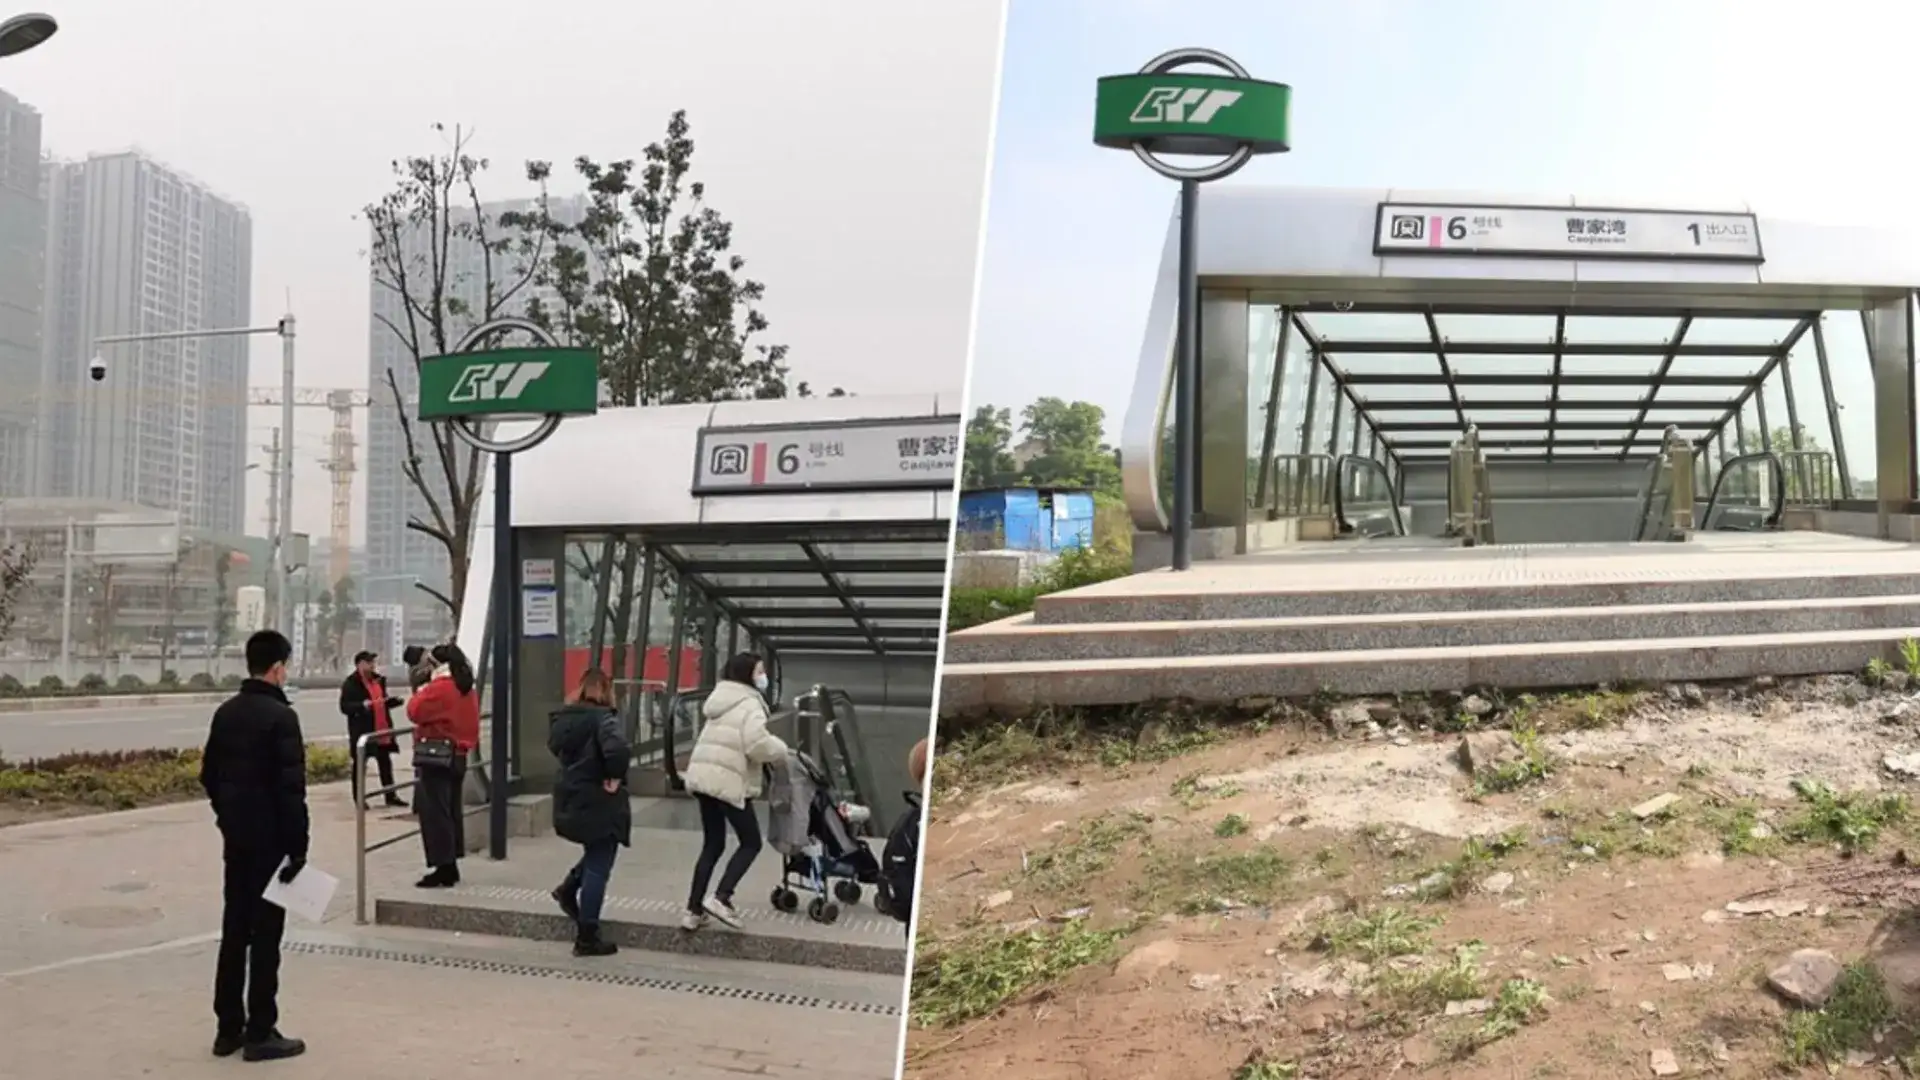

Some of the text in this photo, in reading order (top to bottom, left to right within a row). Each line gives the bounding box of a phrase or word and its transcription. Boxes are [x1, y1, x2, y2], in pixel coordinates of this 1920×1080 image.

[1446, 215, 1503, 240] 6 号线
[1566, 217, 1627, 235] 曹家湾
[1687, 222, 1701, 246] 1
[1705, 222, 1748, 236] 出入口
[777, 439, 845, 475] 6 号线
